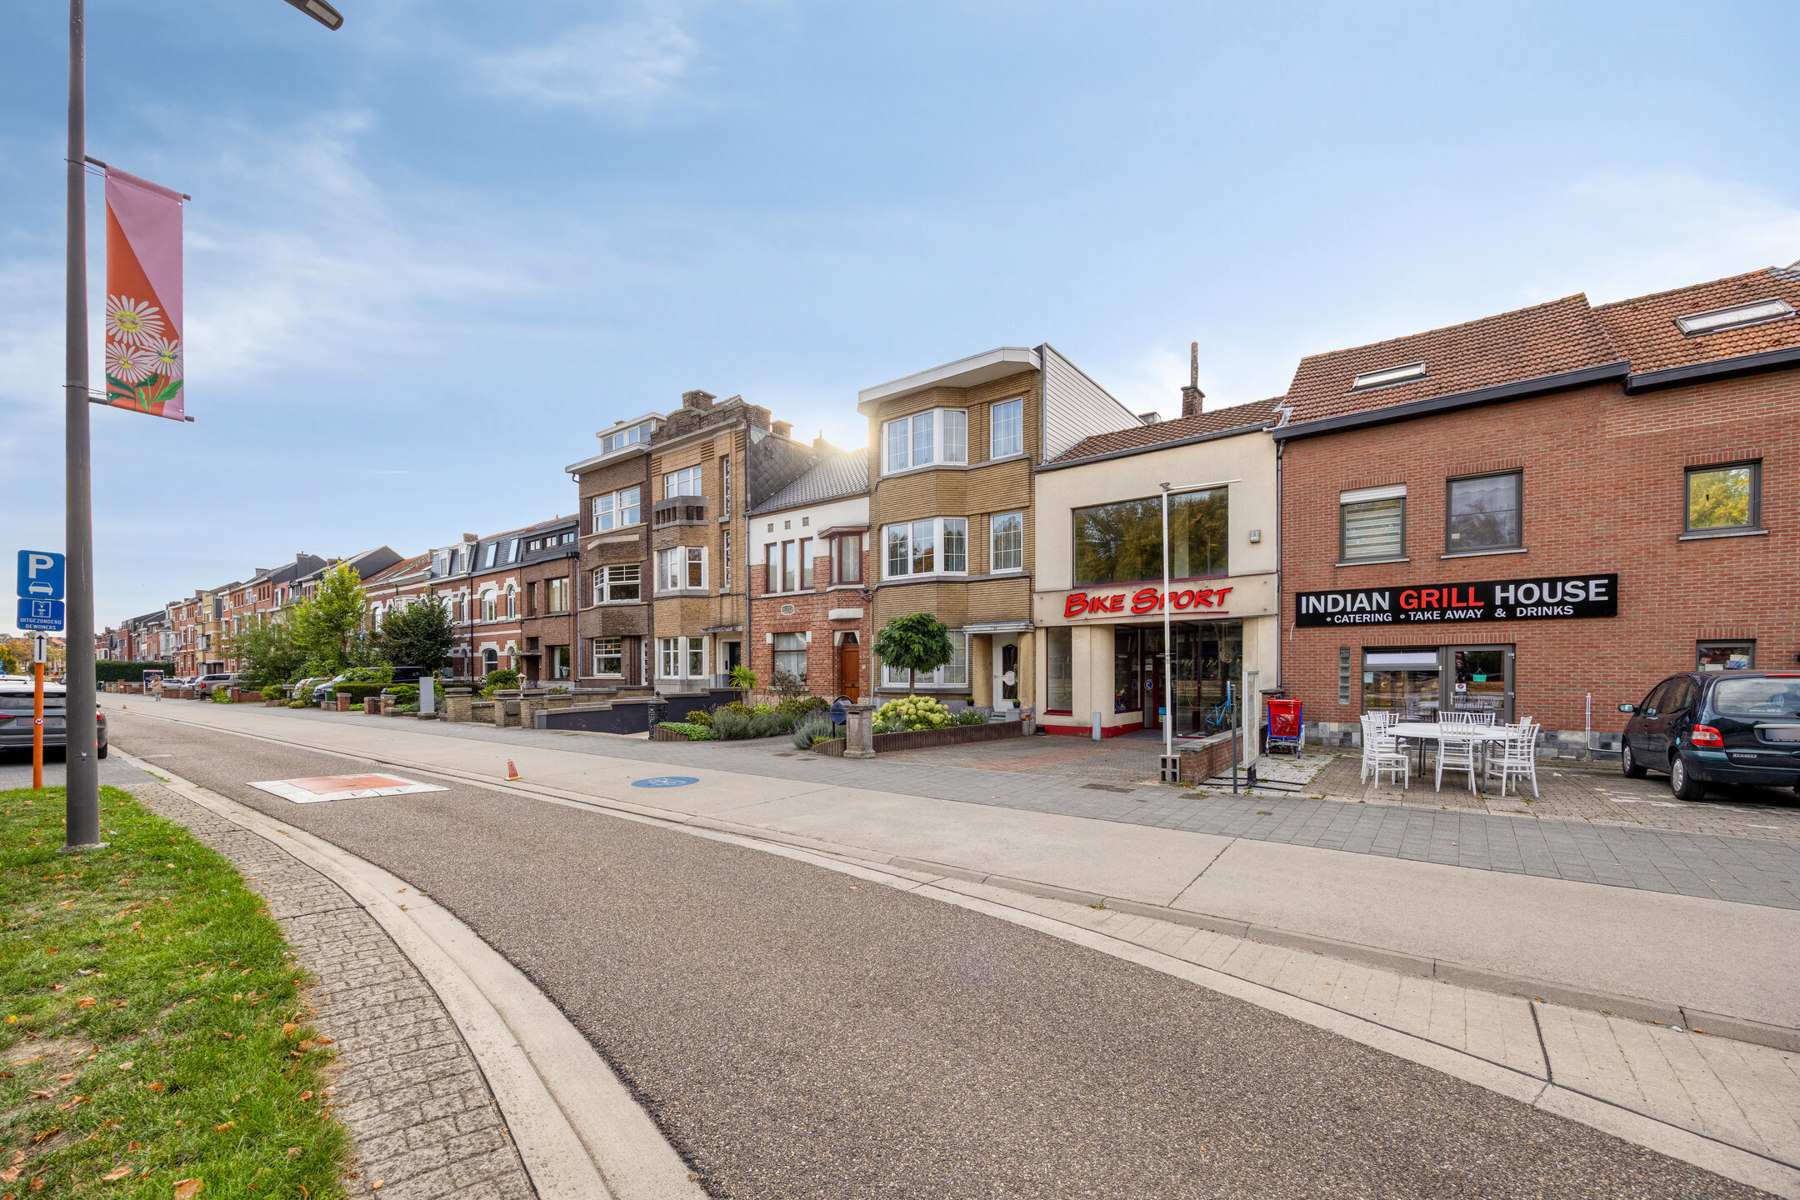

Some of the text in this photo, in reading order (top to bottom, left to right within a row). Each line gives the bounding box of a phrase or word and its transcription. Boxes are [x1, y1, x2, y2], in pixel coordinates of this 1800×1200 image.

[28, 554, 54, 578] P
[1063, 586, 1234, 618] BIKE SPORT
[1301, 579, 1609, 614] INDIAN GRILL HOUSE
[1333, 605, 1574, 624] CATERING TAKE AWAY & DRINKS
